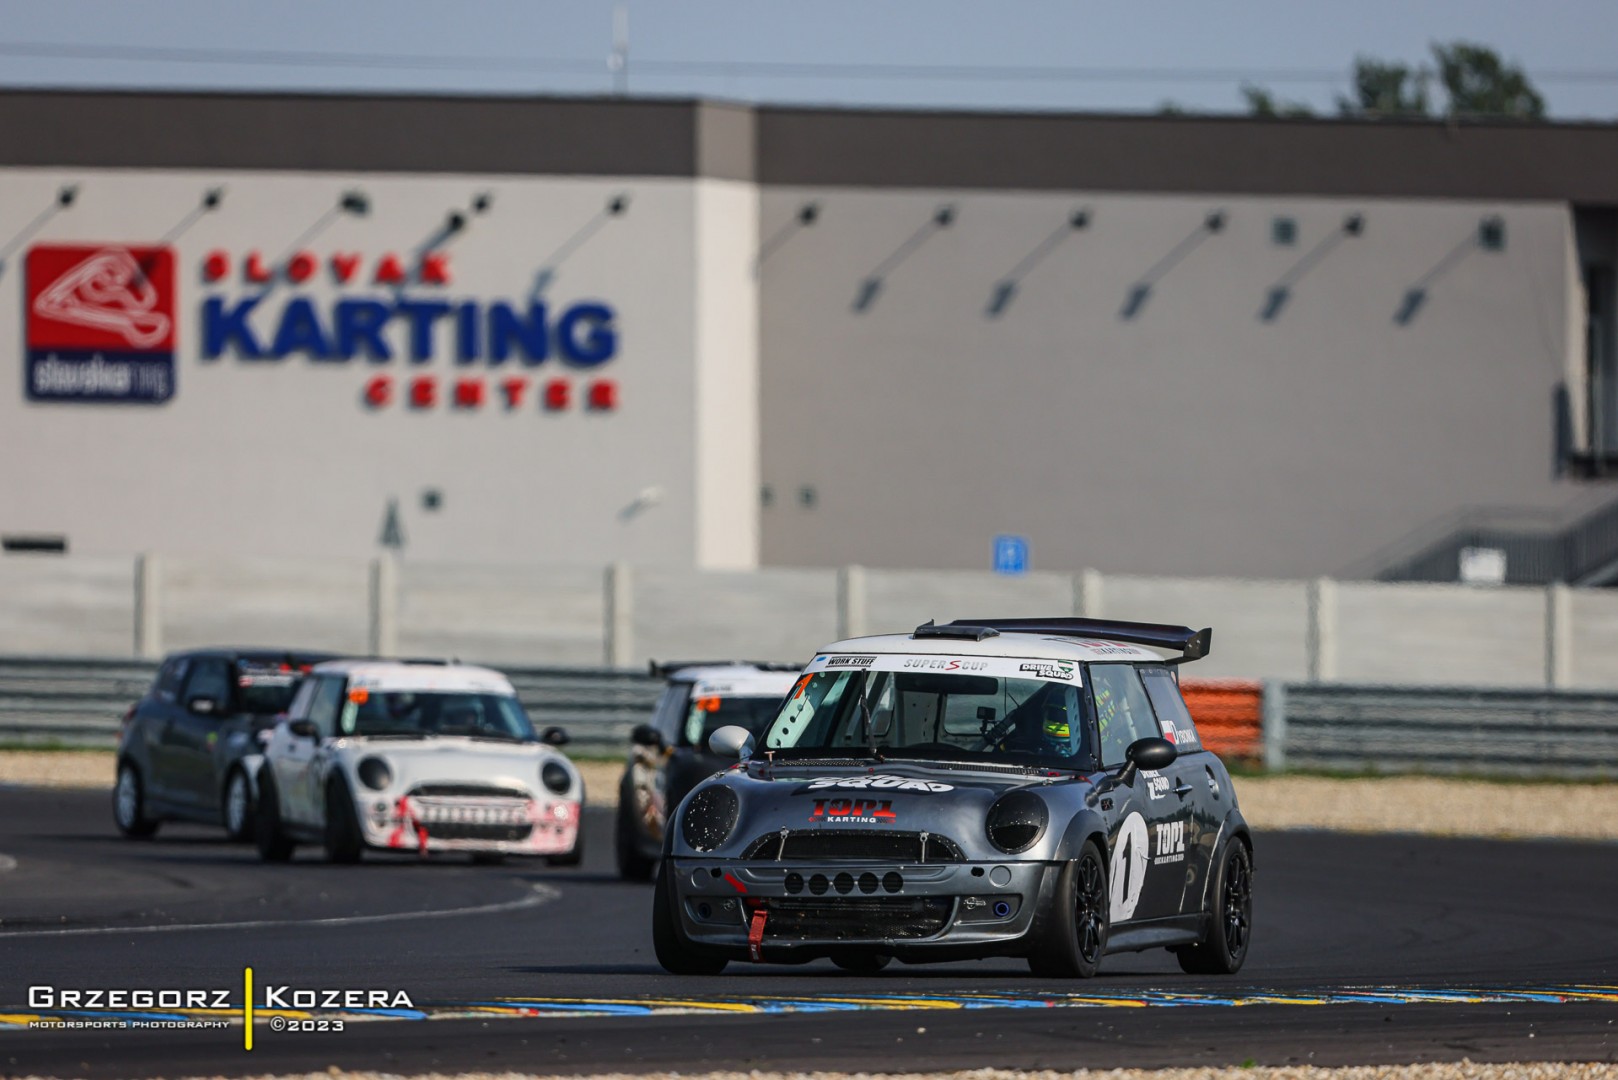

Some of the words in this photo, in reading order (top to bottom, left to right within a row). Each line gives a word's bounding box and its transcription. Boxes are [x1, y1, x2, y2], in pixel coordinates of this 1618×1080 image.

[203, 250, 452, 284] SLOVAK
[200, 297, 620, 367] KARTING
[363, 375, 618, 412] CENTER
[828, 657, 852, 665] WORK
[852, 657, 876, 665] STUFF
[1020, 663, 1053, 672] DRIVE
[1038, 670, 1074, 680] SQUAD
[808, 778, 955, 793] SQUAD
[812, 798, 897, 818] TOP1
[827, 816, 877, 824] KARTING
[1156, 821, 1185, 856] TOP1
[1122, 831, 1133, 905] 1
